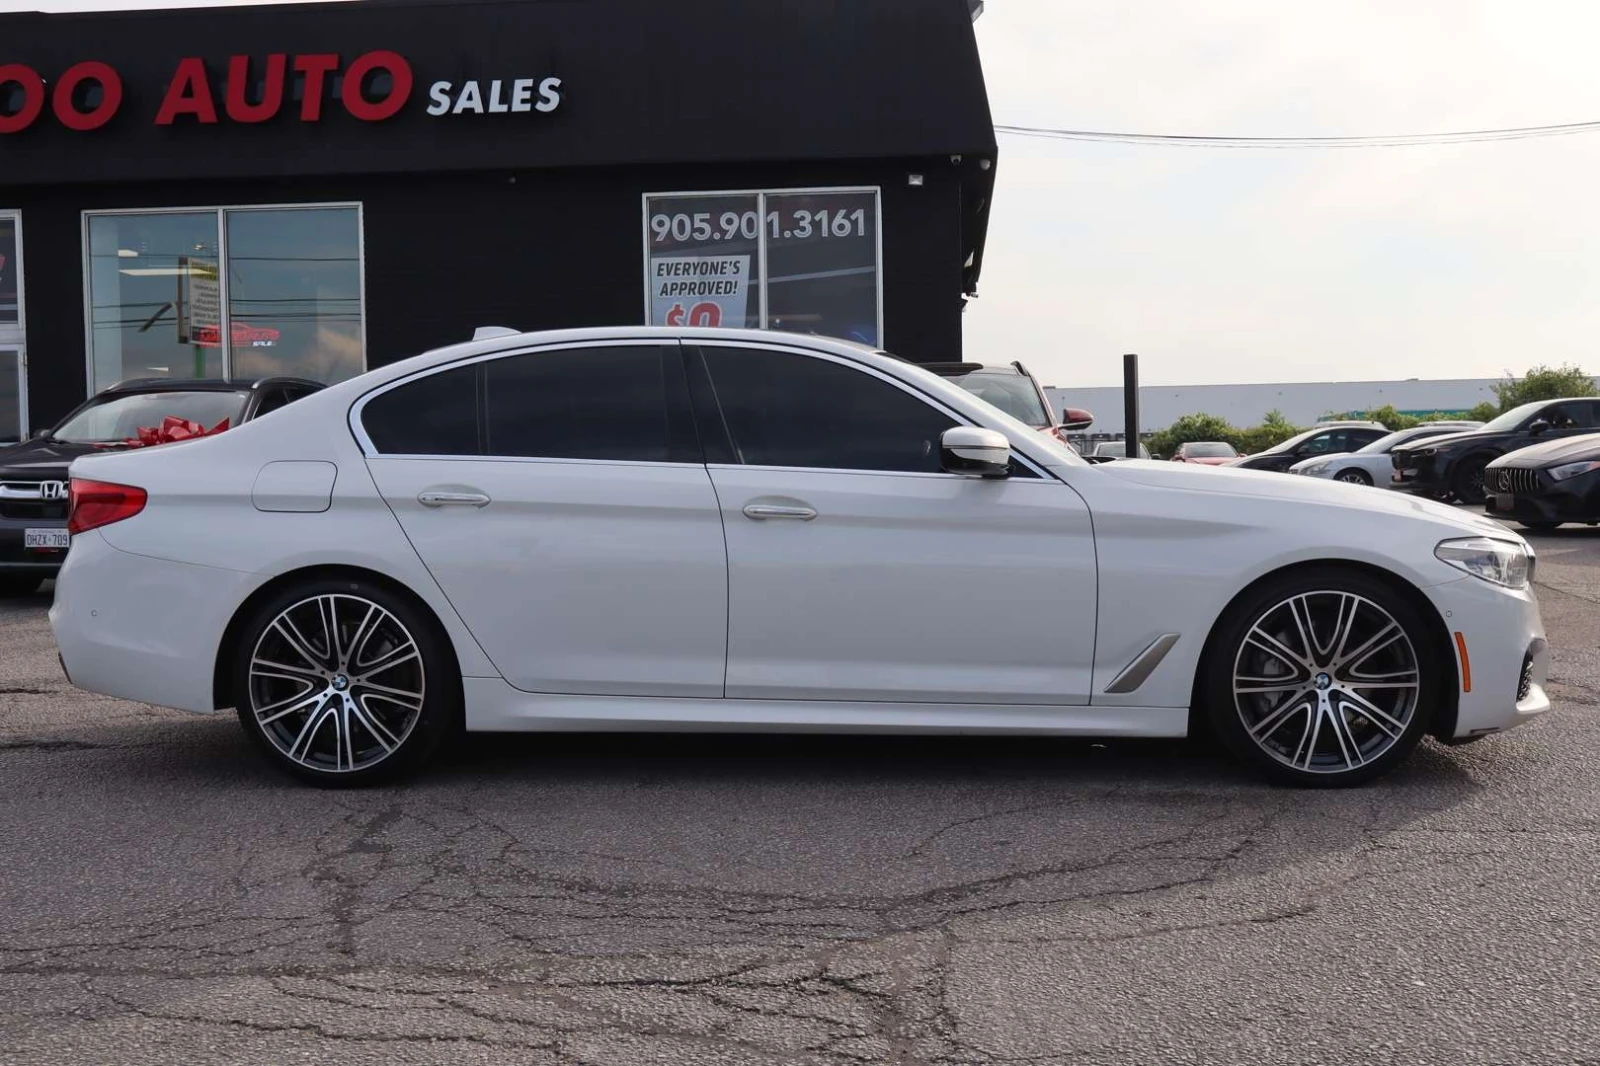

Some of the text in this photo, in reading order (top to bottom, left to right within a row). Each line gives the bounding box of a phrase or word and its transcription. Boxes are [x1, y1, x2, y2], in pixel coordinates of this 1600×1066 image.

[153, 50, 413, 125] AUTO
[426, 77, 561, 116] SALES
[651, 209, 865, 242] 905.901.3161
[657, 260, 740, 277] EVERYONE'S
[660, 281, 738, 297] APPROVED!
